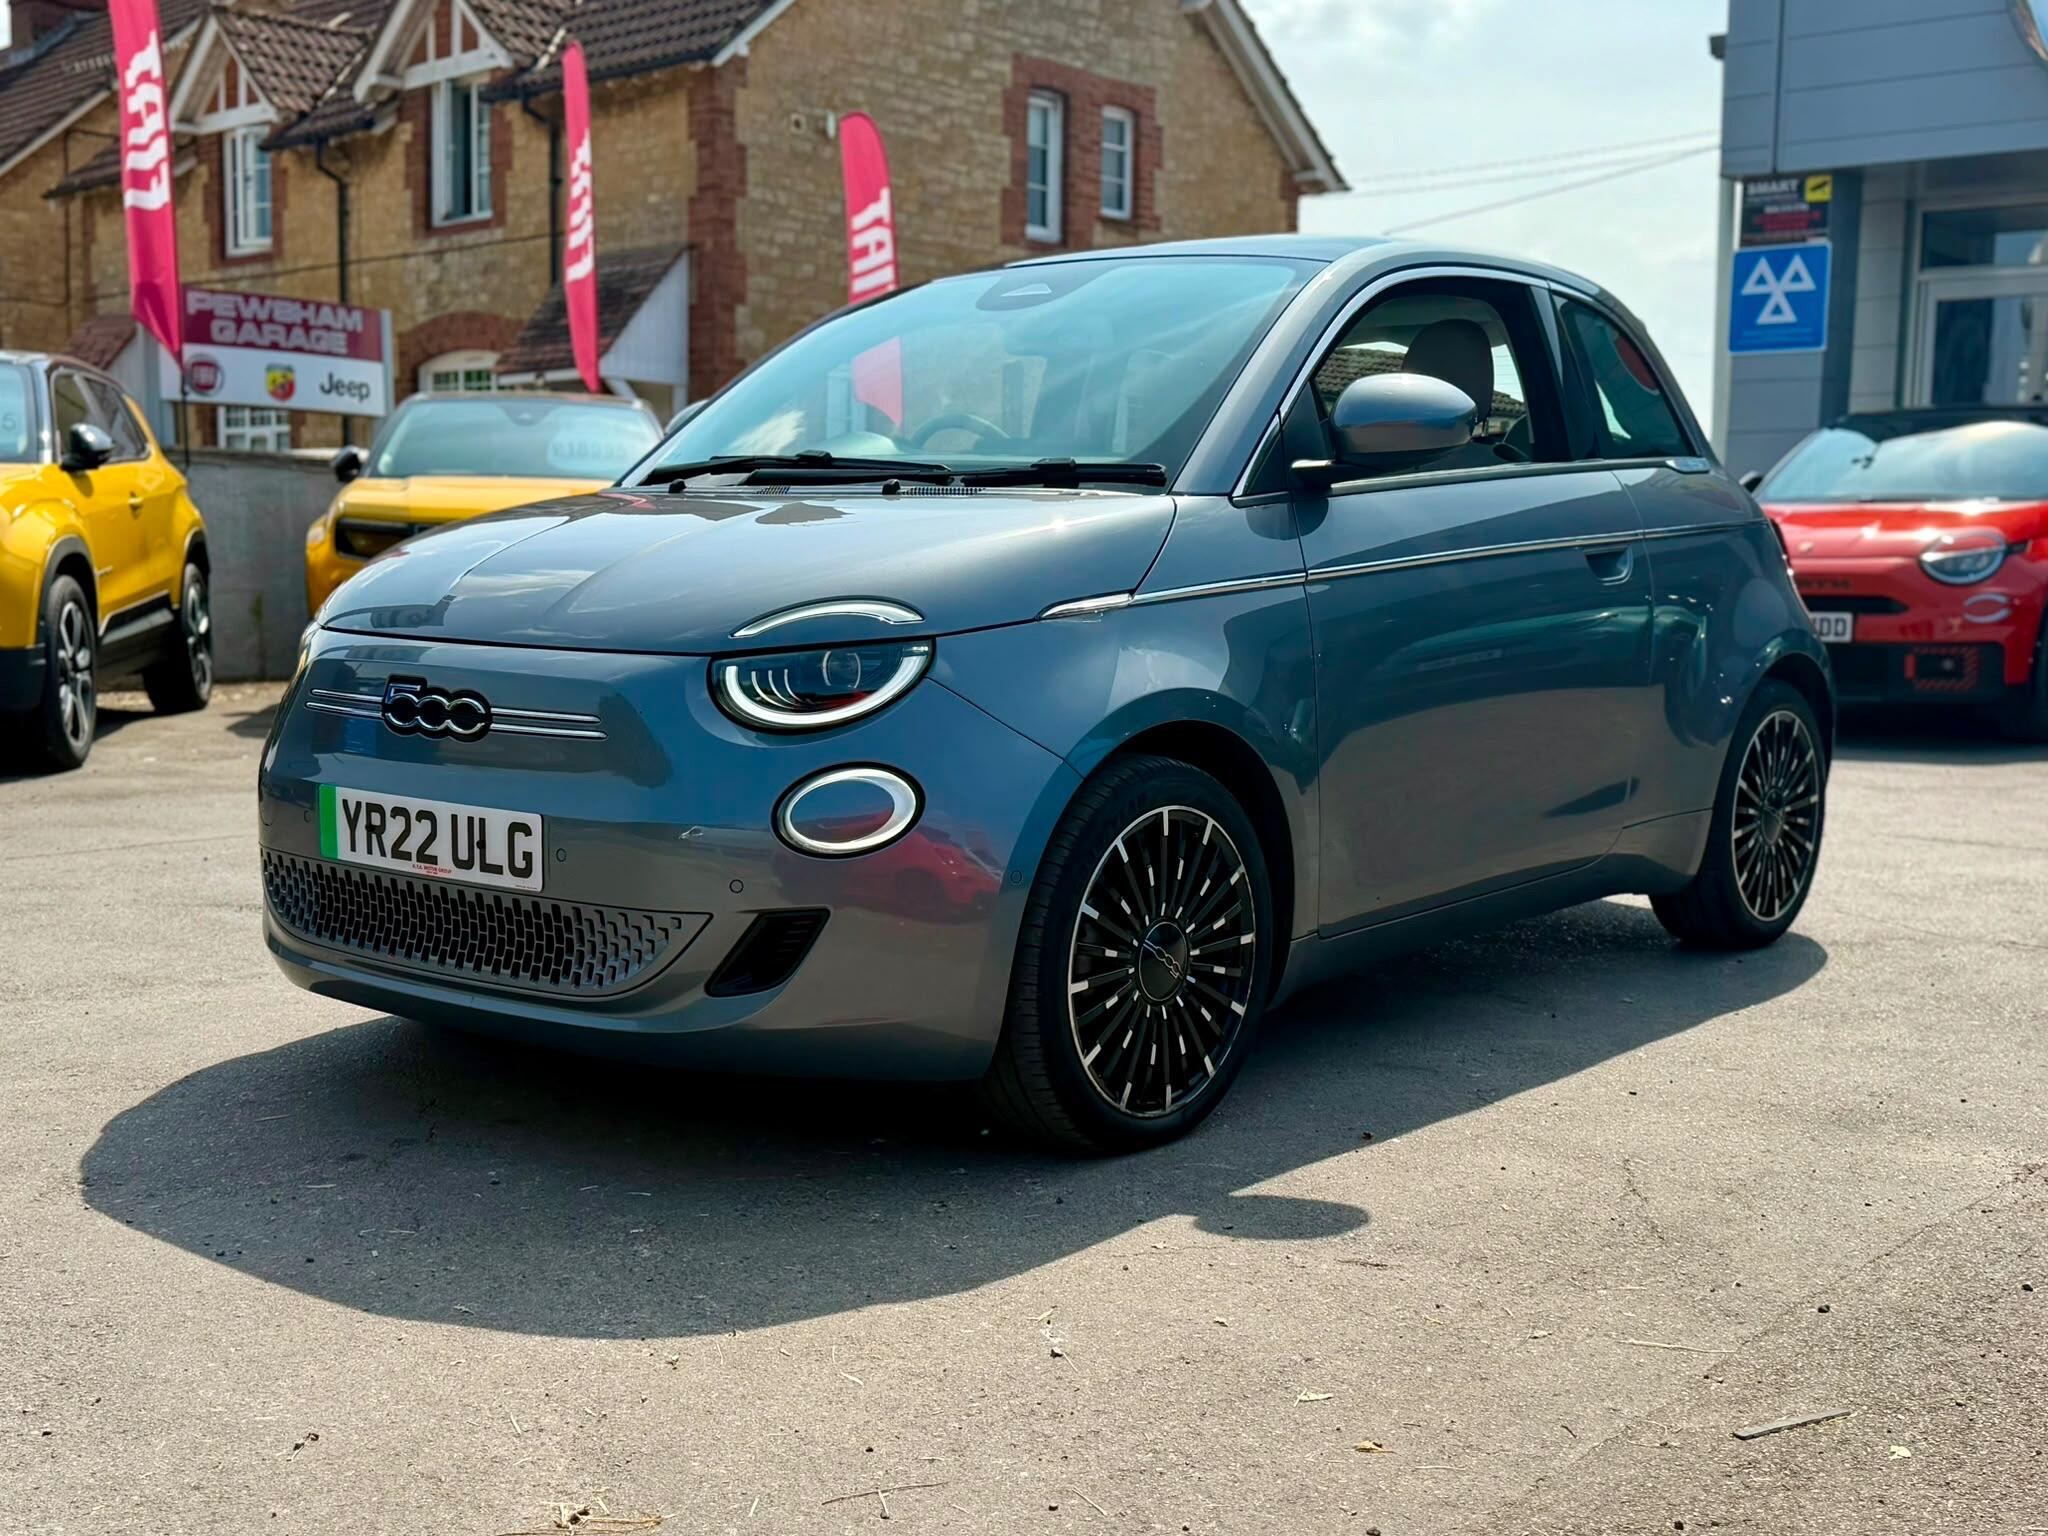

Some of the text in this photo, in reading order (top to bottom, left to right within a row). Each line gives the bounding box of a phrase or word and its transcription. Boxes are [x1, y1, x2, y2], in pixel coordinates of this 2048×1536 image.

[187, 291, 363, 333] PEWSHAM
[210, 319, 348, 354] GARAGE
[320, 373, 371, 402] Jeep
[384, 680, 489, 737] 500
[342, 798, 533, 879] YR22 ULG
